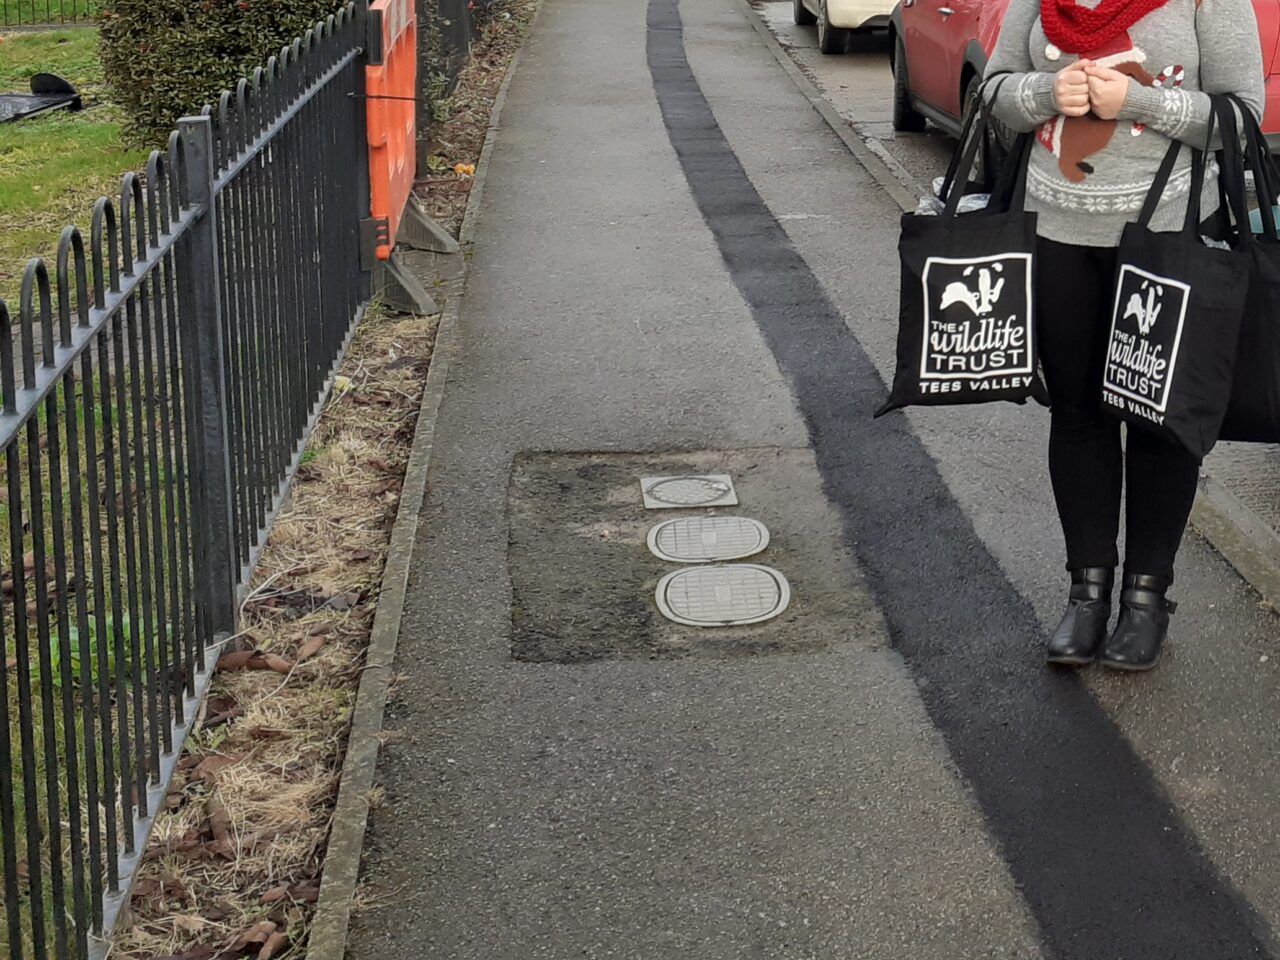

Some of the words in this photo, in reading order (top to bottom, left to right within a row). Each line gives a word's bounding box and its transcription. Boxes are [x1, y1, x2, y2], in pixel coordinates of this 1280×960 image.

[930, 320, 957, 333] THE
[930, 314, 1025, 353] wildlife
[1114, 329, 1129, 343] THE
[930, 348, 1025, 371] TRUST
[1110, 334, 1167, 381] wildlife
[919, 380, 962, 394] TEES
[969, 375, 1033, 391] VALLEY
[1108, 363, 1162, 399] TRUST
[1102, 390, 1125, 409] TEES
[1127, 400, 1165, 426] VALLEY
